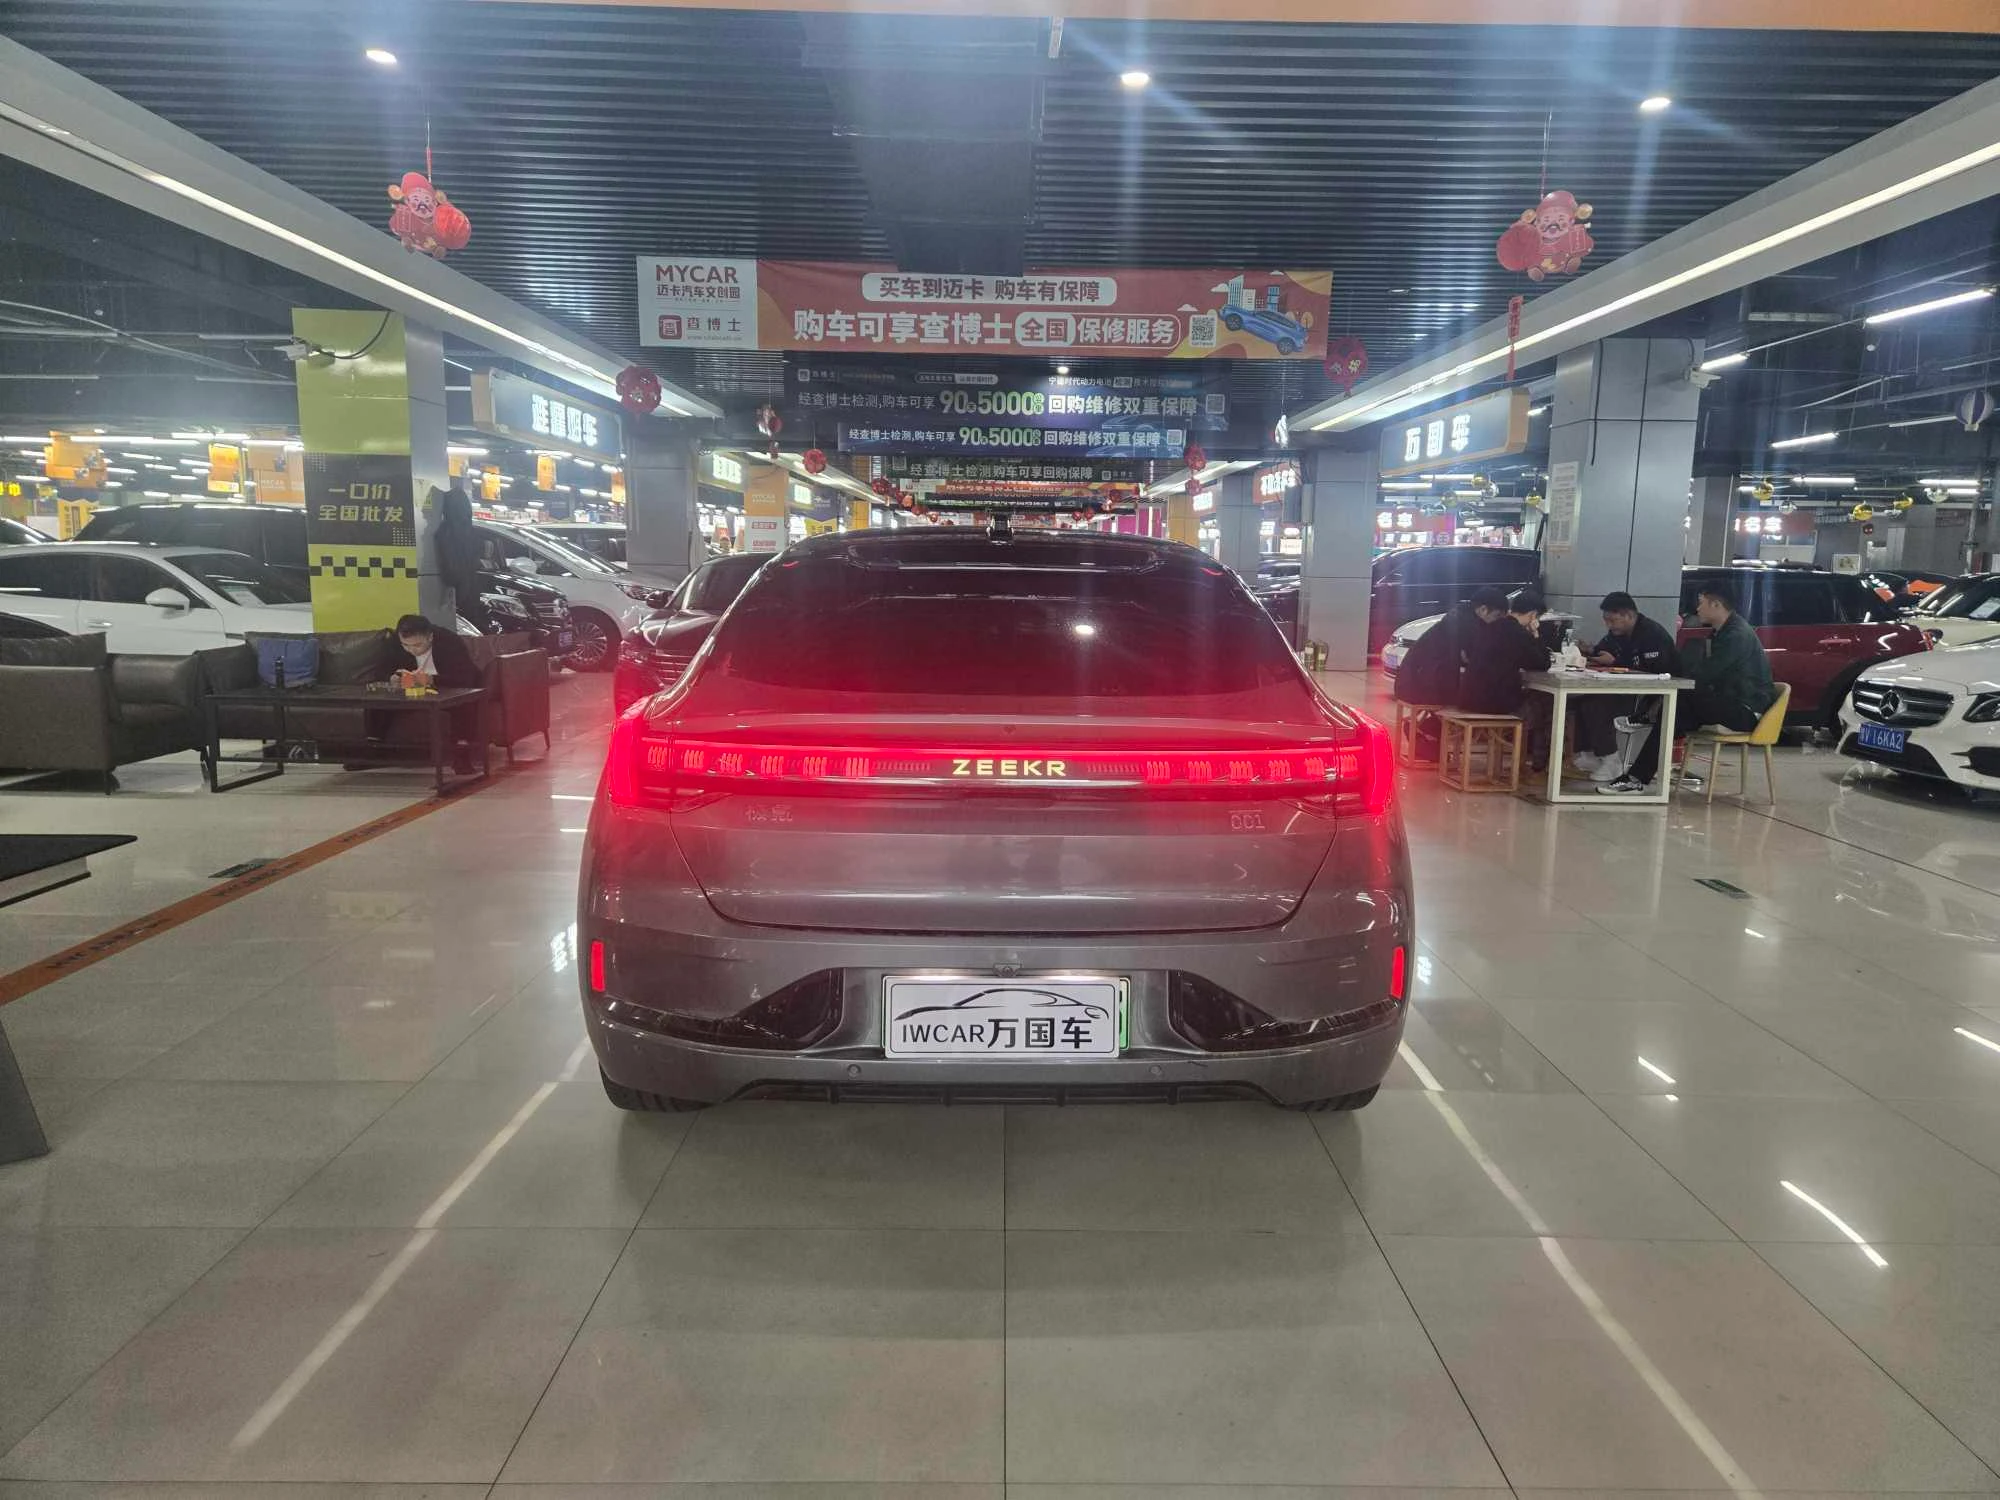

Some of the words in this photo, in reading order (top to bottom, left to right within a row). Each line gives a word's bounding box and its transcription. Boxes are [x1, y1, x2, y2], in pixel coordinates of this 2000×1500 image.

[656, 265, 738, 283] MYCAR
[657, 284, 740, 299] 迈卡汽车文创园
[880, 277, 984, 299] 买车到迈卡
[995, 279, 1100, 302] 购车有保障
[1404, 414, 1471, 463] 万国车
[327, 483, 392, 500] 一口价
[318, 504, 404, 522] 全国批发
[952, 759, 1067, 777] ZEEKR
[1230, 814, 1265, 829] 001
